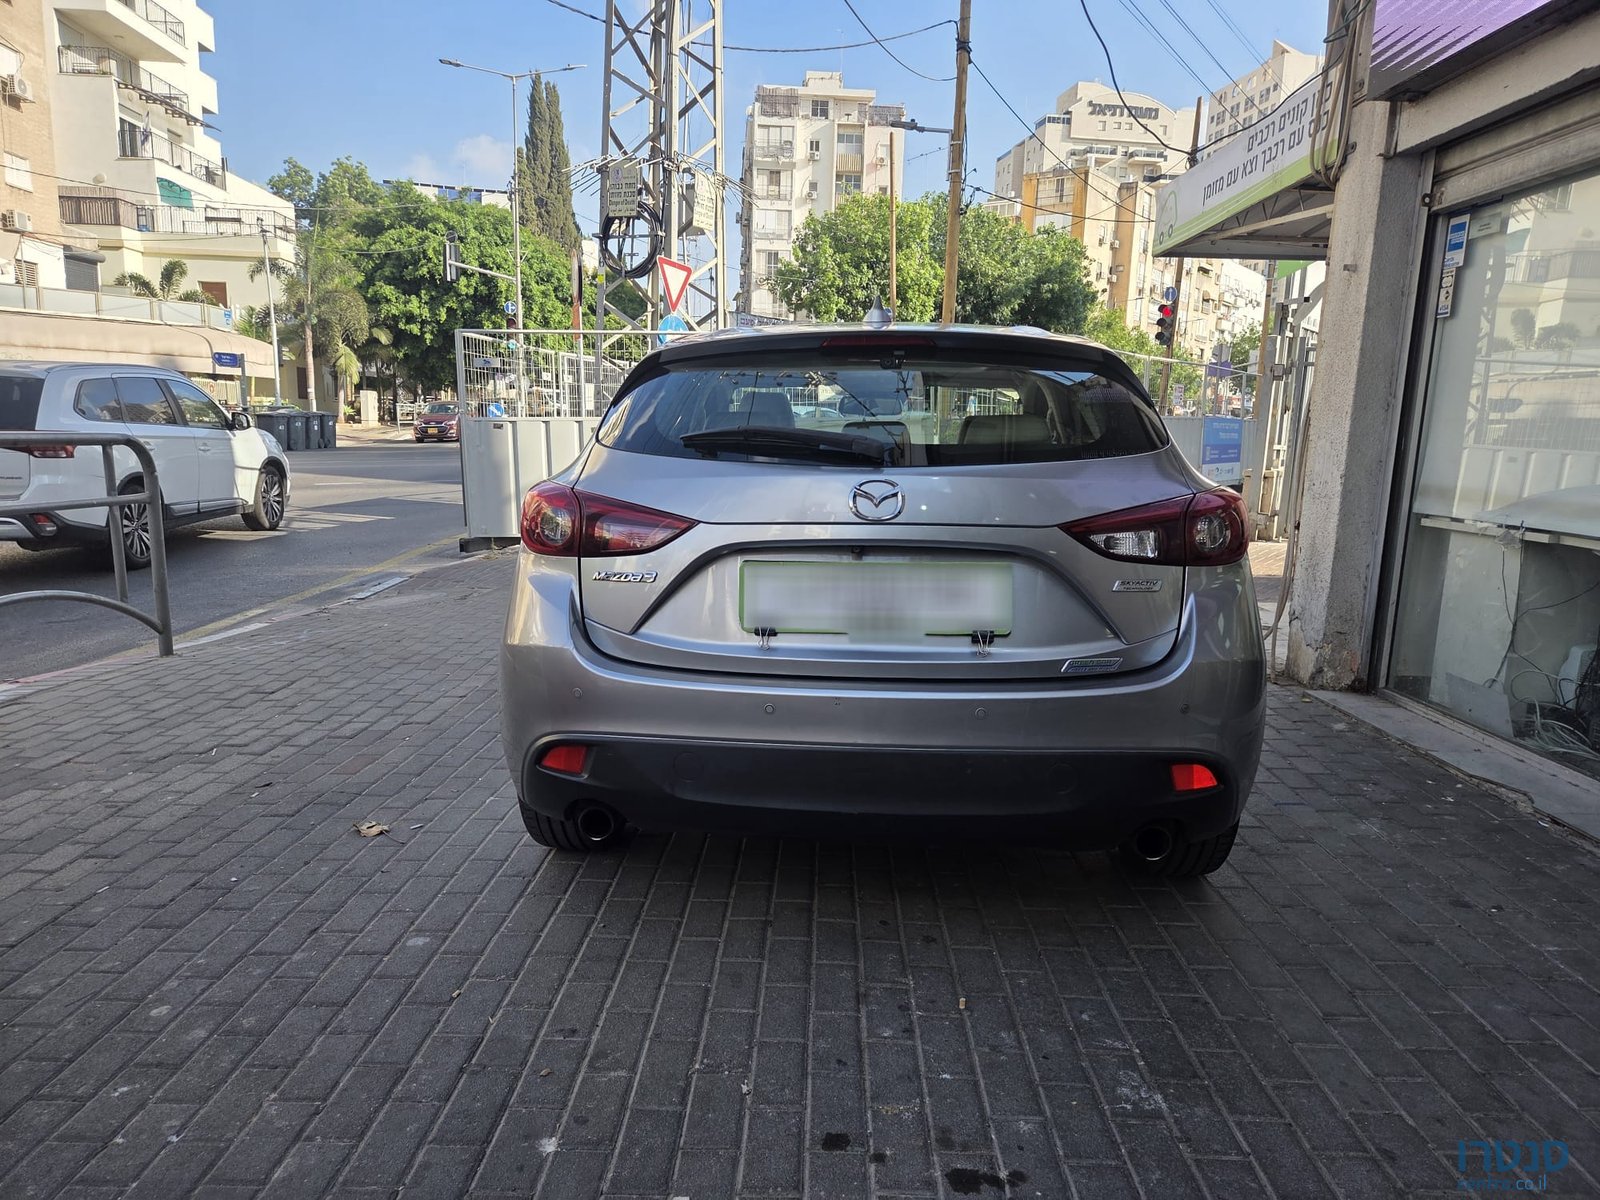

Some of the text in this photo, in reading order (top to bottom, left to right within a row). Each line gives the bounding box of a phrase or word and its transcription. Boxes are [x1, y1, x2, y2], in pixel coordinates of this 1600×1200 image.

[1087, 100, 1125, 117] דניאל
[1247, 81, 1333, 153] כן קונים רכבים
[1287, 125, 1305, 152] עם
[1241, 154, 1259, 180] וצא
[1261, 138, 1285, 172] רכבך
[1226, 166, 1239, 189] עם
[1202, 176, 1225, 207] מזומן
